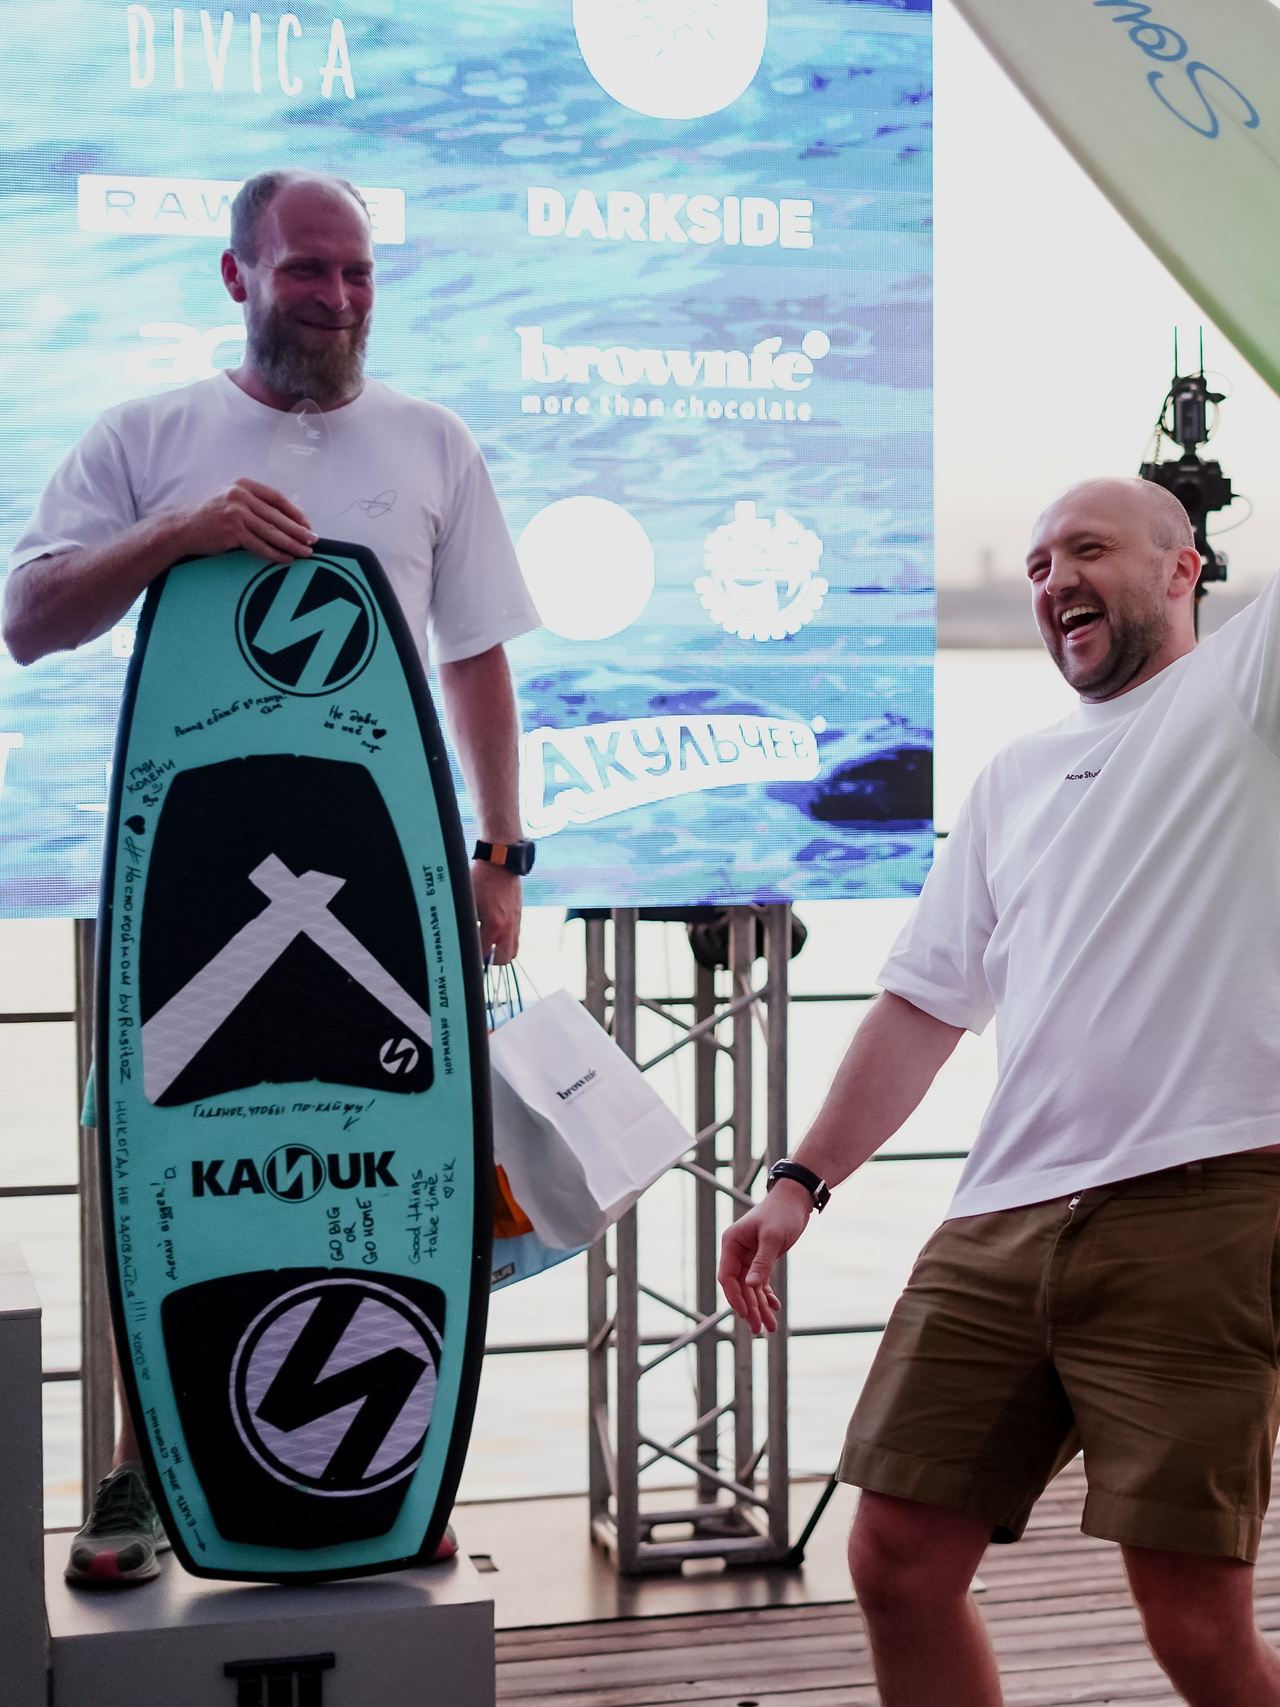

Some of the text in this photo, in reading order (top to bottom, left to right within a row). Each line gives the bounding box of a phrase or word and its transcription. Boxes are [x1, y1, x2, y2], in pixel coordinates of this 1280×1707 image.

[127, 4, 356, 99] DIVICA
[527, 186, 814, 249] DARKSIDE
[521, 393, 812, 422] more than chocolate
[541, 722, 810, 808] АКУЛЬЧЕВ
[326, 1206, 344, 1262] GO BIG
[343, 1222, 357, 1243] OR
[423, 1172, 439, 1258] take time
